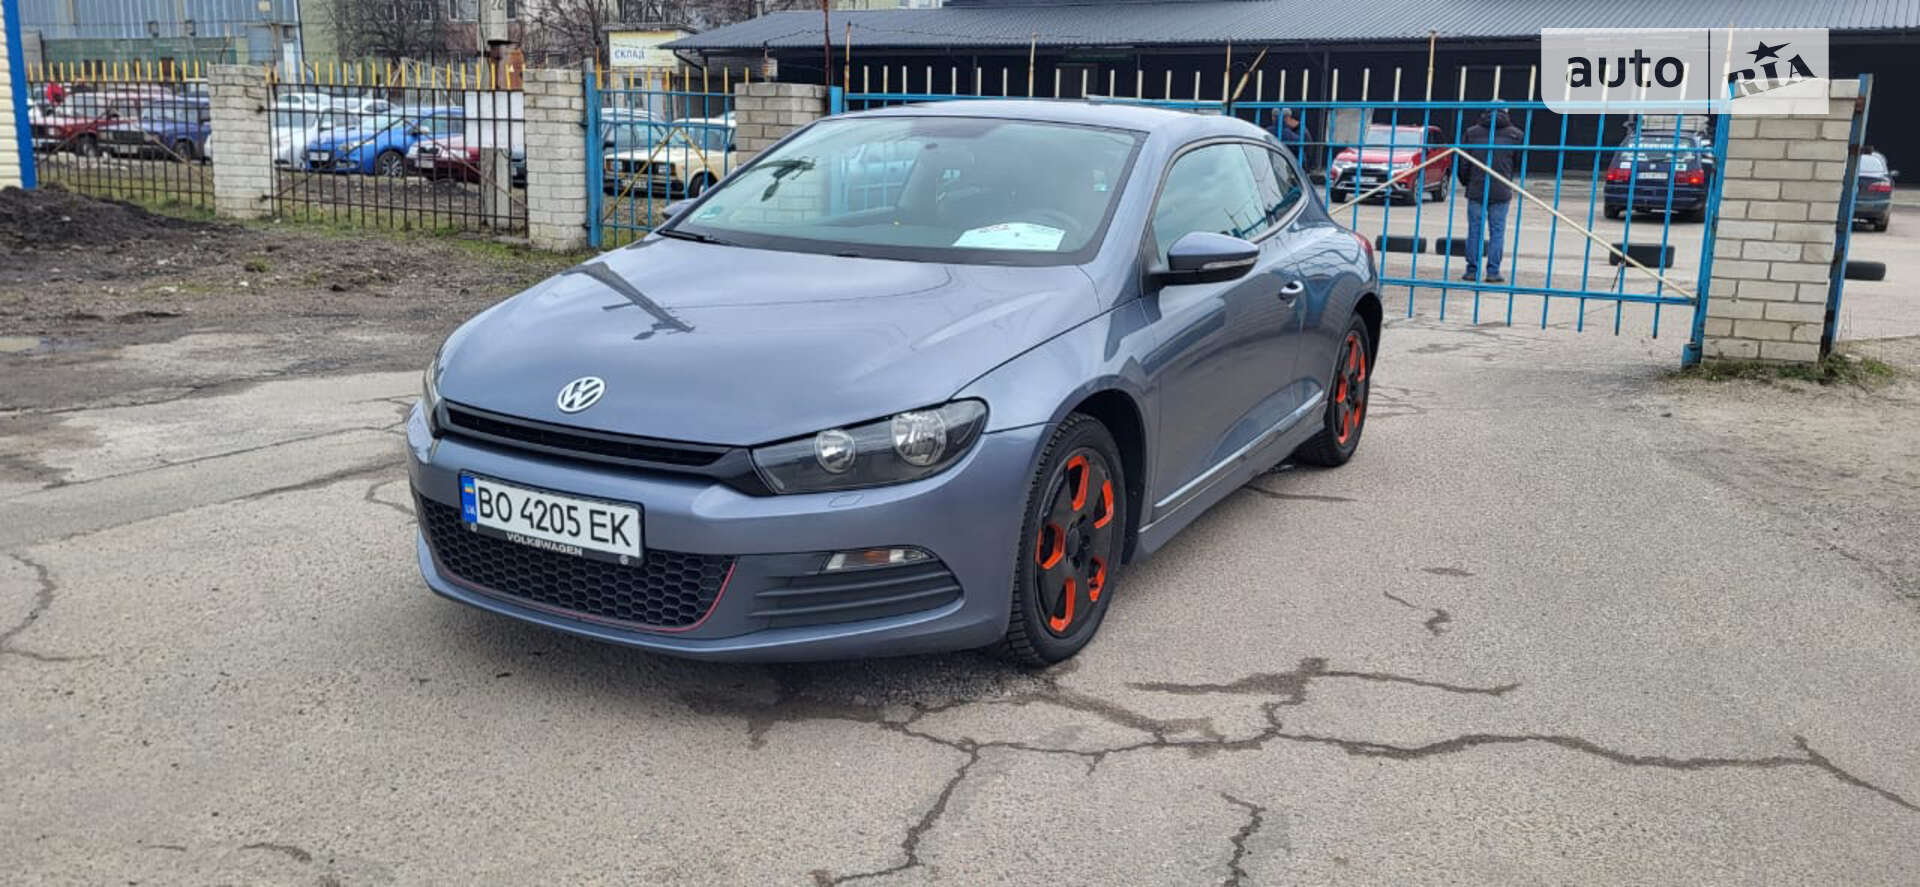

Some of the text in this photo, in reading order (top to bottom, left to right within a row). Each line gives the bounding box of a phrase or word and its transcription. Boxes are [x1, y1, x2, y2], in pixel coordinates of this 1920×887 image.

[614, 48, 646, 60] СКЛАД
[478, 487, 632, 547] BO 4205 EK
[506, 532, 583, 557] VOLKSWAGEN
